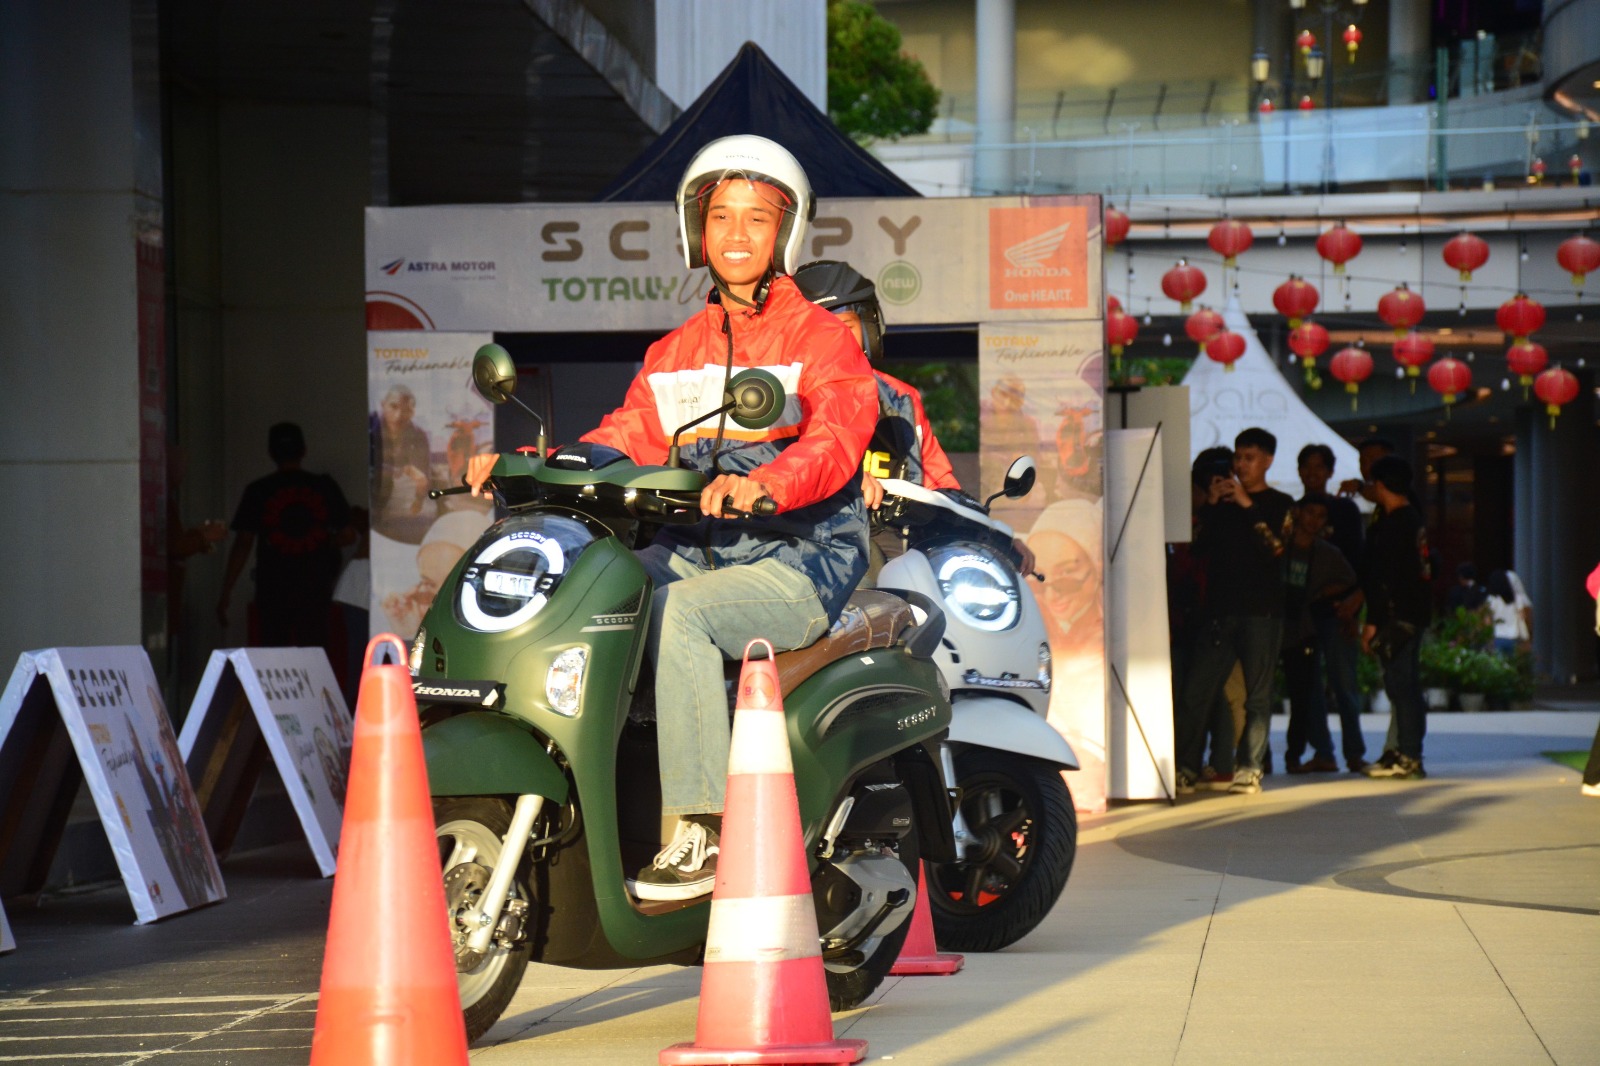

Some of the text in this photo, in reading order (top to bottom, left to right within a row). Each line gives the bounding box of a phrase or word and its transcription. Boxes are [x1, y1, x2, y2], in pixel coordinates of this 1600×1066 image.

[541, 214, 922, 263] SCPY
[407, 261, 496, 272] ASTRA MOTOR
[1004, 267, 1072, 278] HONDA
[542, 276, 678, 302] TOTALLY
[1004, 289, 1029, 302] One
[985, 335, 1039, 348] TOTALLY
[374, 347, 430, 359] TOTALLY
[994, 344, 1085, 363] Fashionable
[384, 355, 471, 374] Fashionable
[555, 454, 587, 464] HONDA
[511, 531, 546, 543] SCOOPY
[595, 617, 635, 625] SCOOPY
[68, 668, 134, 708] SCOOPY
[256, 668, 315, 700] SCOOPY
[416, 686, 481, 697] HONDA
[897, 705, 937, 731] SCOOPY
